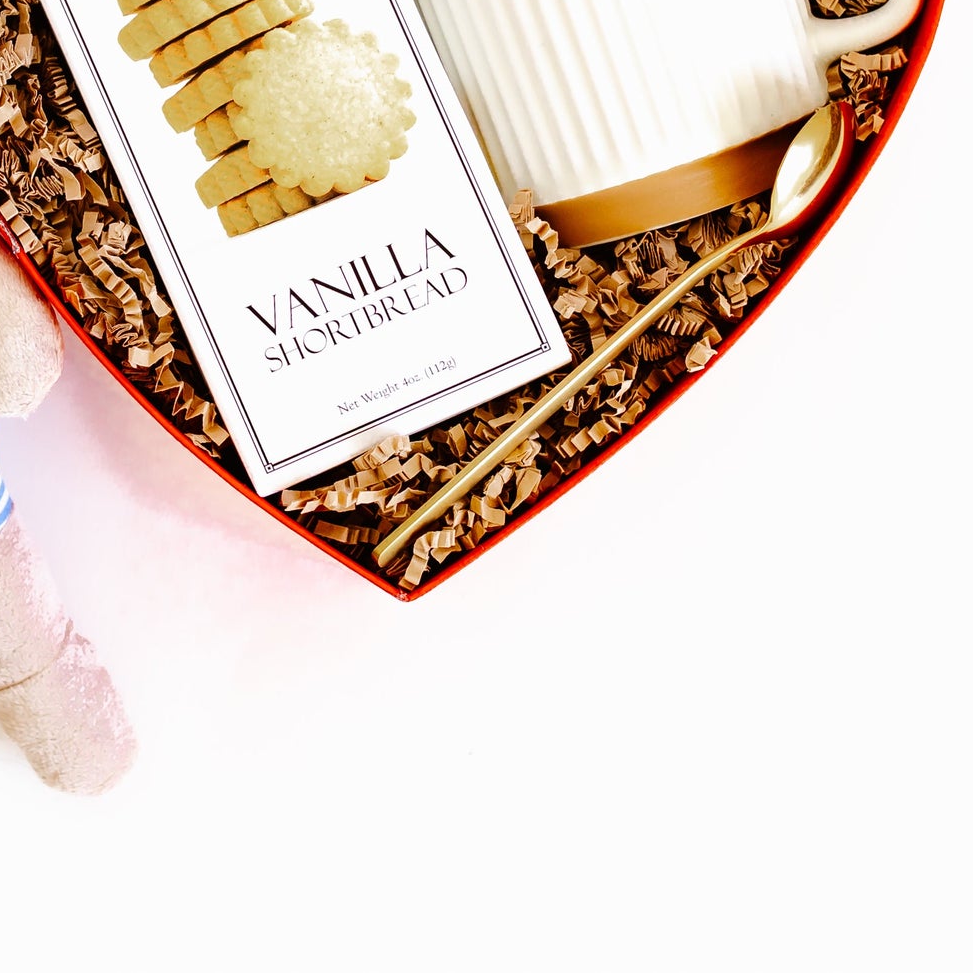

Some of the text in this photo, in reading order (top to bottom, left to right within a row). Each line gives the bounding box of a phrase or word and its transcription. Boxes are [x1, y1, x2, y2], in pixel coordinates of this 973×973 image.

[245, 228, 456, 336] VANILLA
[264, 267, 468, 373] SHORTBREAD
[337, 402, 360, 415] Net
[360, 383, 400, 403] Weight
[424, 356, 457, 379] (112g)
